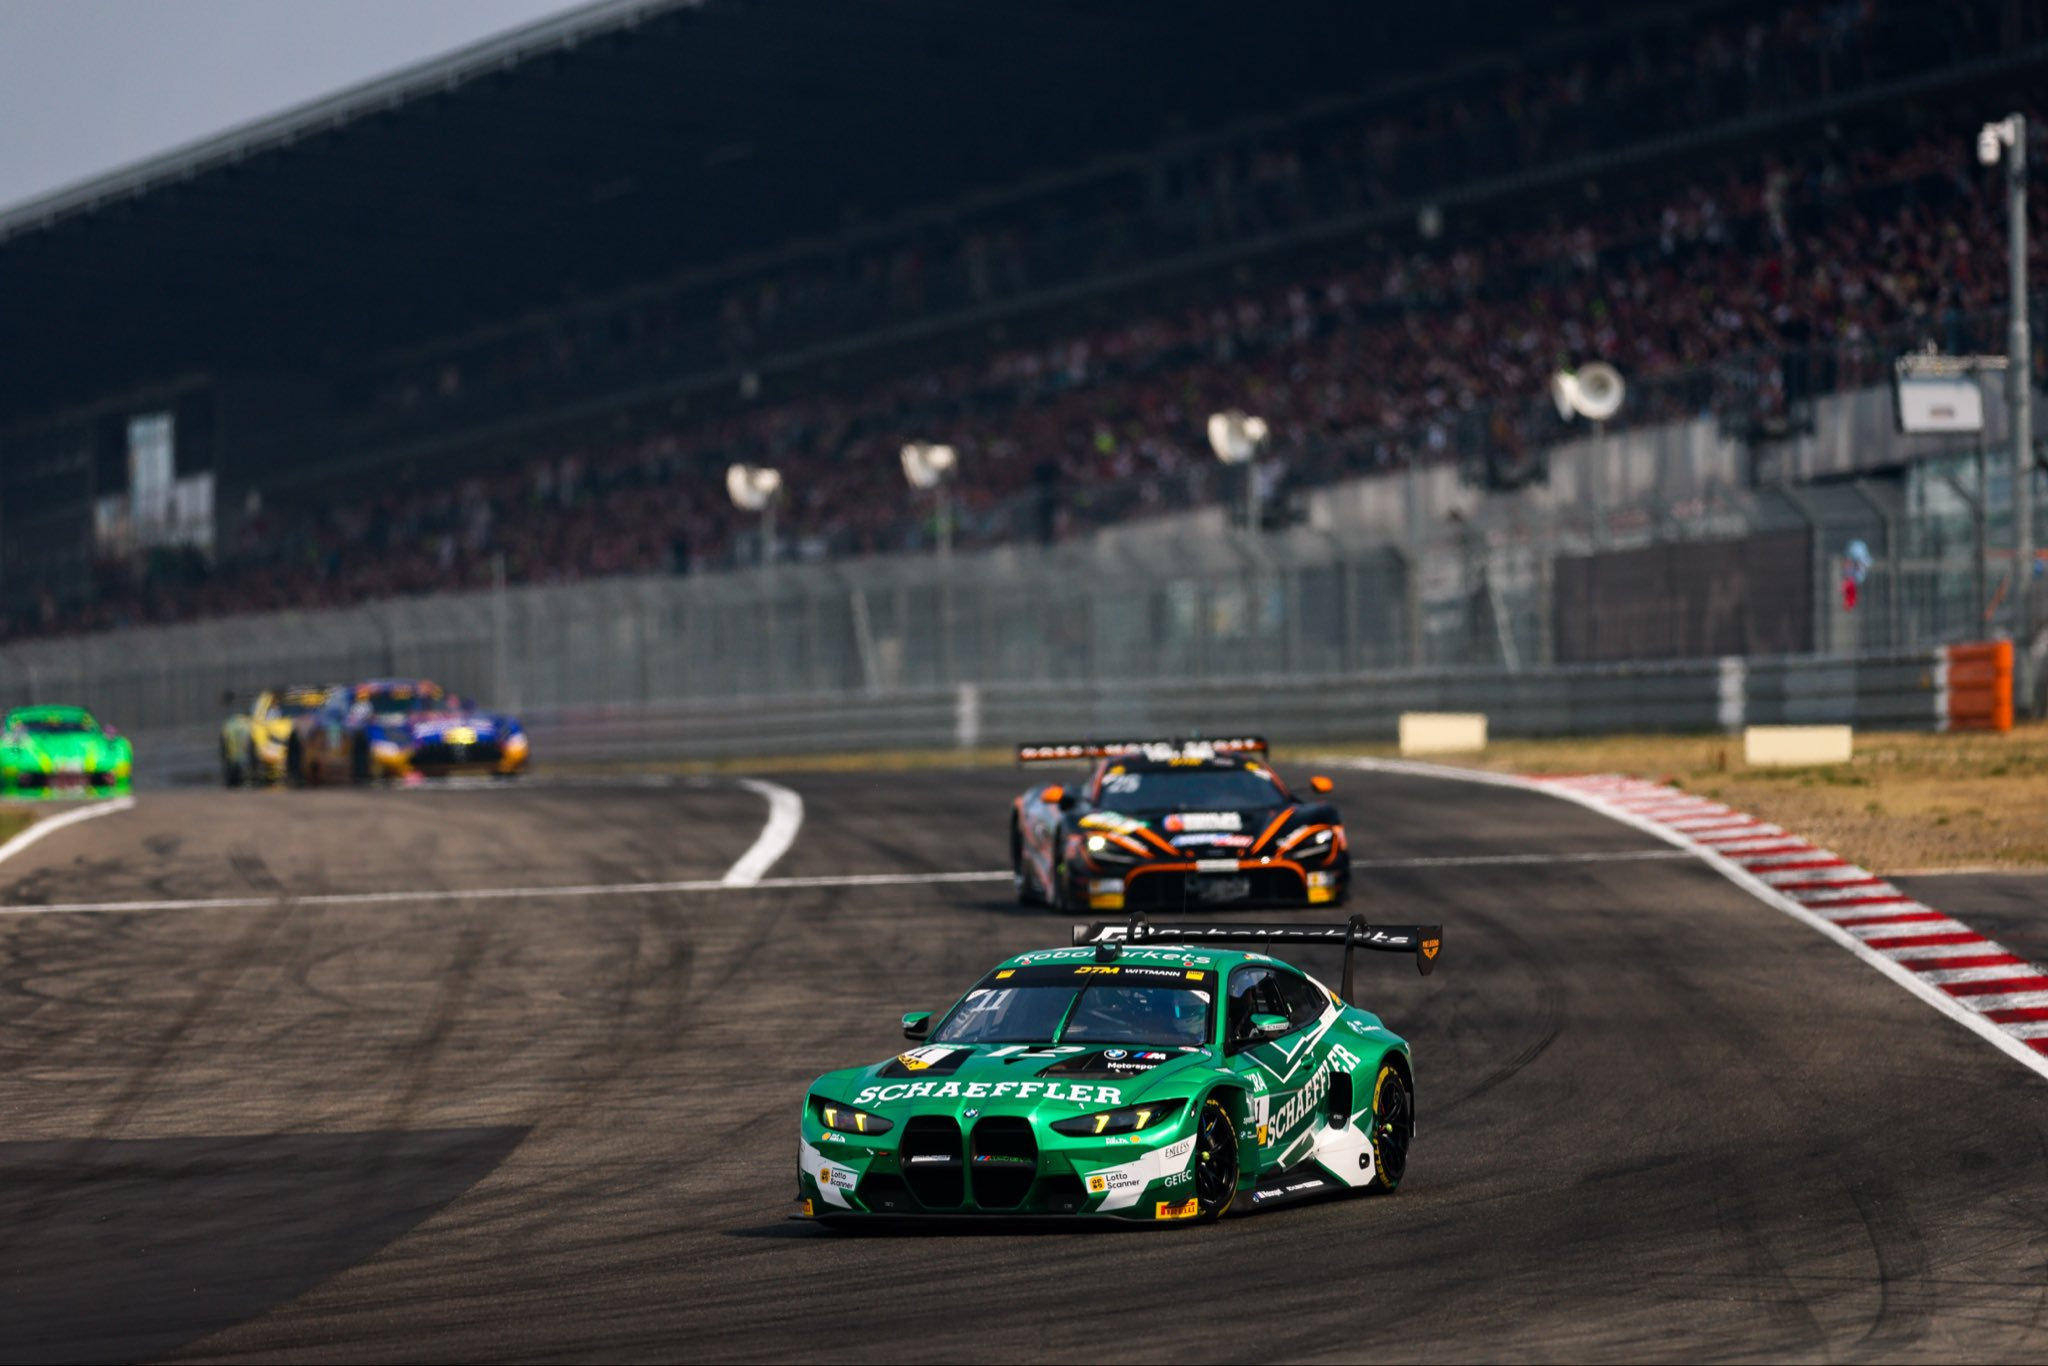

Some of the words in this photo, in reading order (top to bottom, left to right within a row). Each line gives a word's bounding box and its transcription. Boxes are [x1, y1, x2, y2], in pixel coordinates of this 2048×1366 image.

[1014, 950, 1210, 965] Roboarkets
[1074, 966, 1120, 975] DTM
[1125, 968, 1180, 977] WITTMANN
[971, 988, 1010, 1012] 11
[1107, 1062, 1159, 1071] Motorspor
[853, 1082, 1121, 1105] SCHAEFFLER
[831, 1169, 847, 1180] Lotto
[1106, 1173, 1128, 1183] Lotto
[1165, 1170, 1192, 1187] GETEC
[830, 1177, 853, 1189] Scanner
[1107, 1180, 1140, 1189] Scanner
